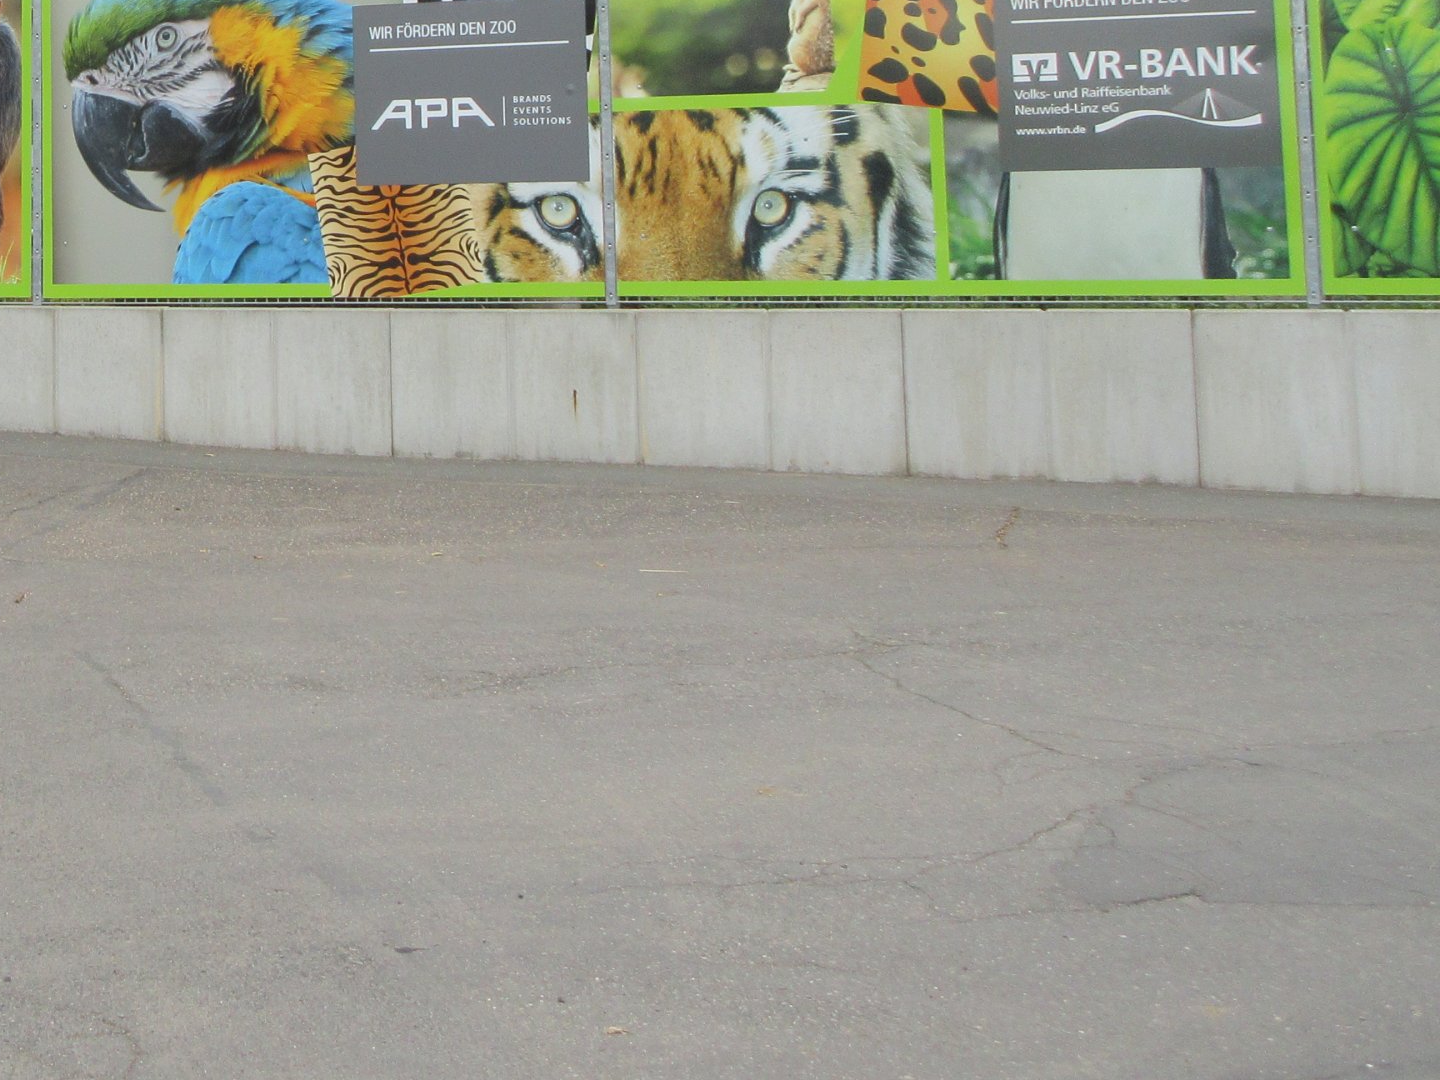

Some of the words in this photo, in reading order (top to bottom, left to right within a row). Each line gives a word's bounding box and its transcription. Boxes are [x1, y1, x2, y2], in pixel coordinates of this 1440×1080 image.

[369, 24, 393, 40] WIR
[396, 22, 456, 38] FÖRDERN
[459, 21, 486, 36] DEN
[489, 19, 517, 34] ZOO
[1068, 44, 1259, 81] VR-BANK
[512, 94, 552, 104] BRANDS
[1013, 88, 1051, 101] Volks-
[1053, 87, 1078, 99] und
[1081, 84, 1172, 98] Raiffeisenbank
[371, 97, 496, 131] APA
[512, 106, 552, 115] EVENTS
[1014, 103, 1099, 116] Neuwied-Linz
[1101, 101, 1120, 114] eG
[513, 116, 572, 127] SOLUTIONS
[1016, 125, 1087, 136] www.vrbn.de
